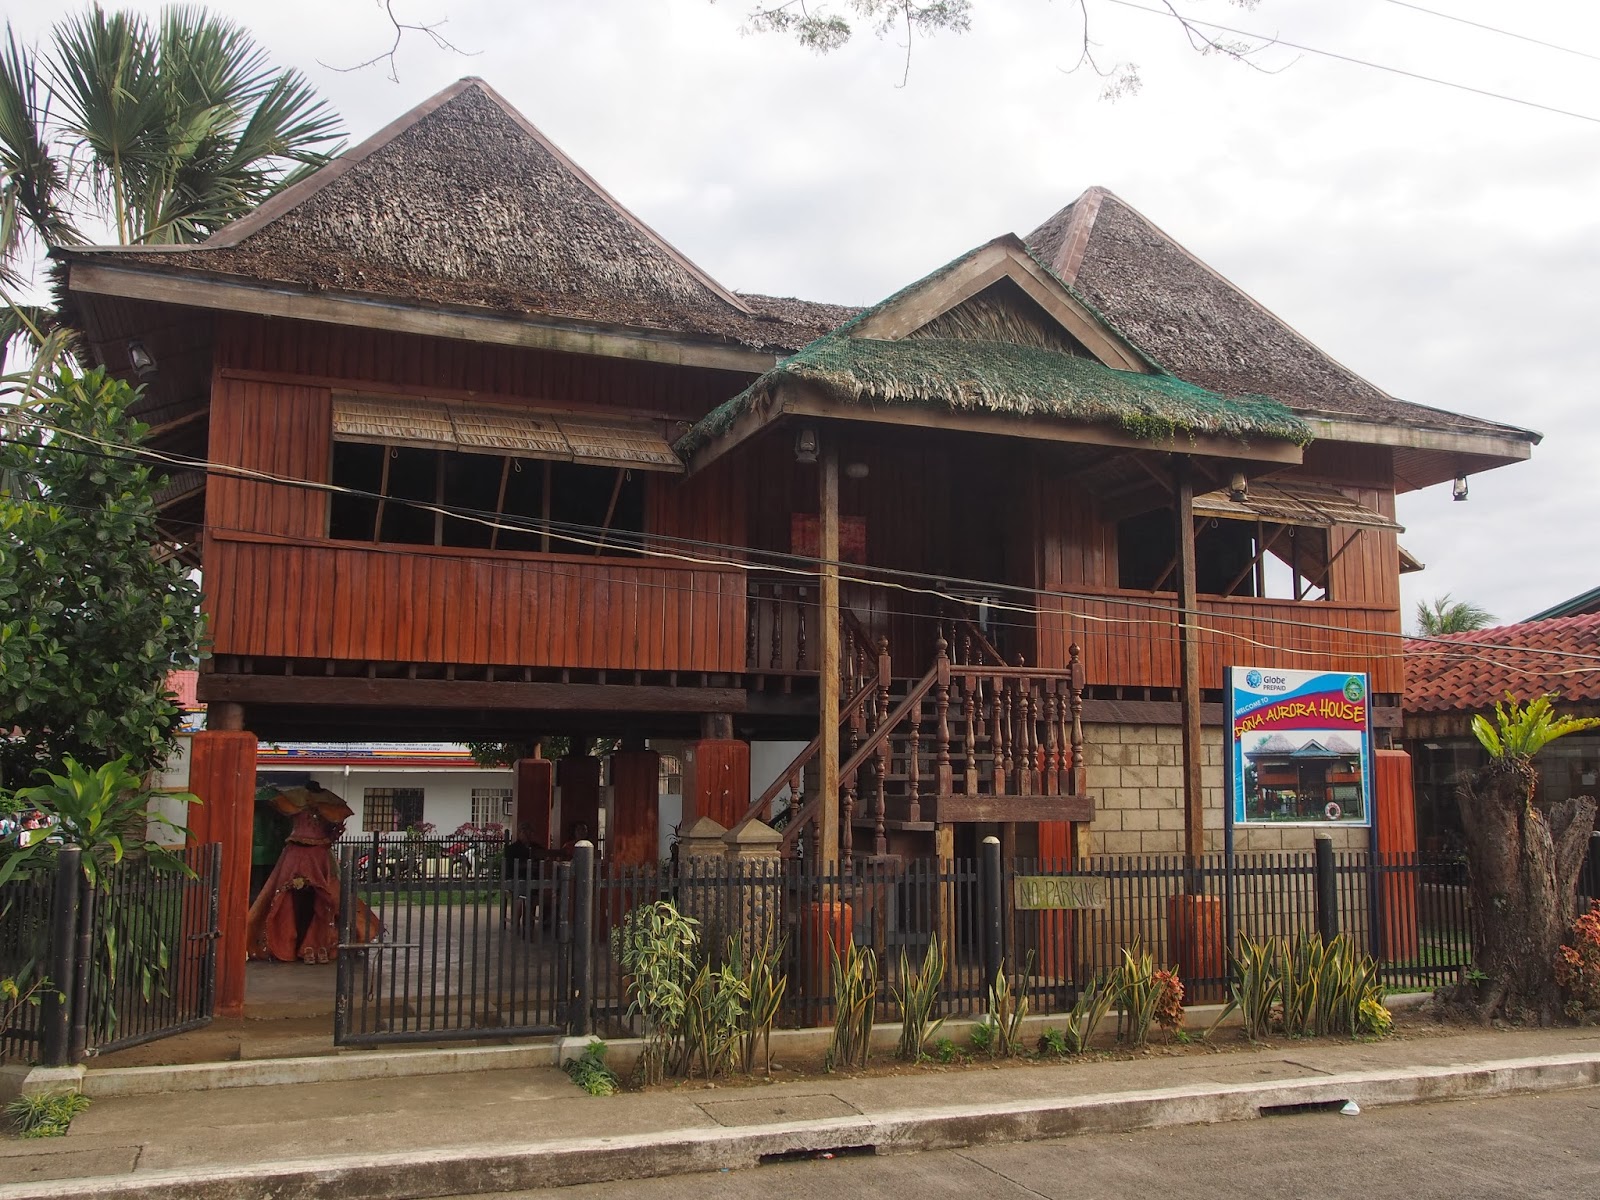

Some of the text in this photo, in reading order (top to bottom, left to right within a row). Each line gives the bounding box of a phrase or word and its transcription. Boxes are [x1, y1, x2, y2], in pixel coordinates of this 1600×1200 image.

[1263, 675, 1286, 684] Globe
[1235, 696, 1269, 715] WELCOME TO
[1234, 698, 1365, 737] DOÑA AURORA HOUSE
[1020, 880, 1102, 907] NO PARKING
